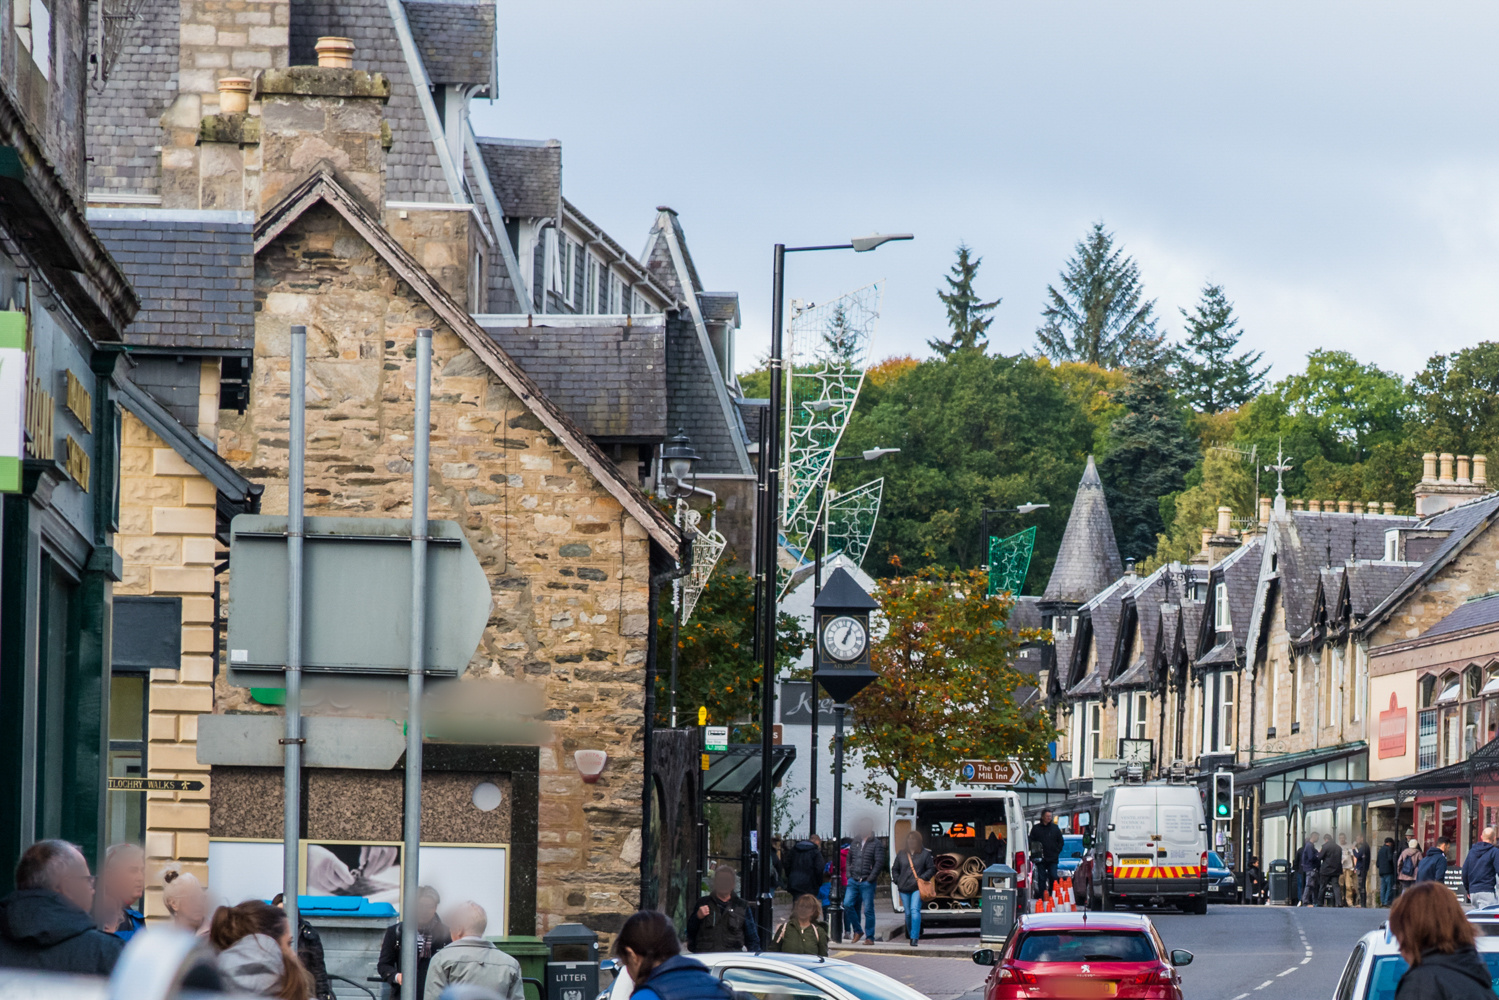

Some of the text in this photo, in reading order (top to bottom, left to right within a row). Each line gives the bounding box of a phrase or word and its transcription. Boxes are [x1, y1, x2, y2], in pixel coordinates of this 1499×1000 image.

[978, 764, 992, 772] The
[147, 781, 175, 790] WALKS
[555, 973, 587, 983] LITTER
